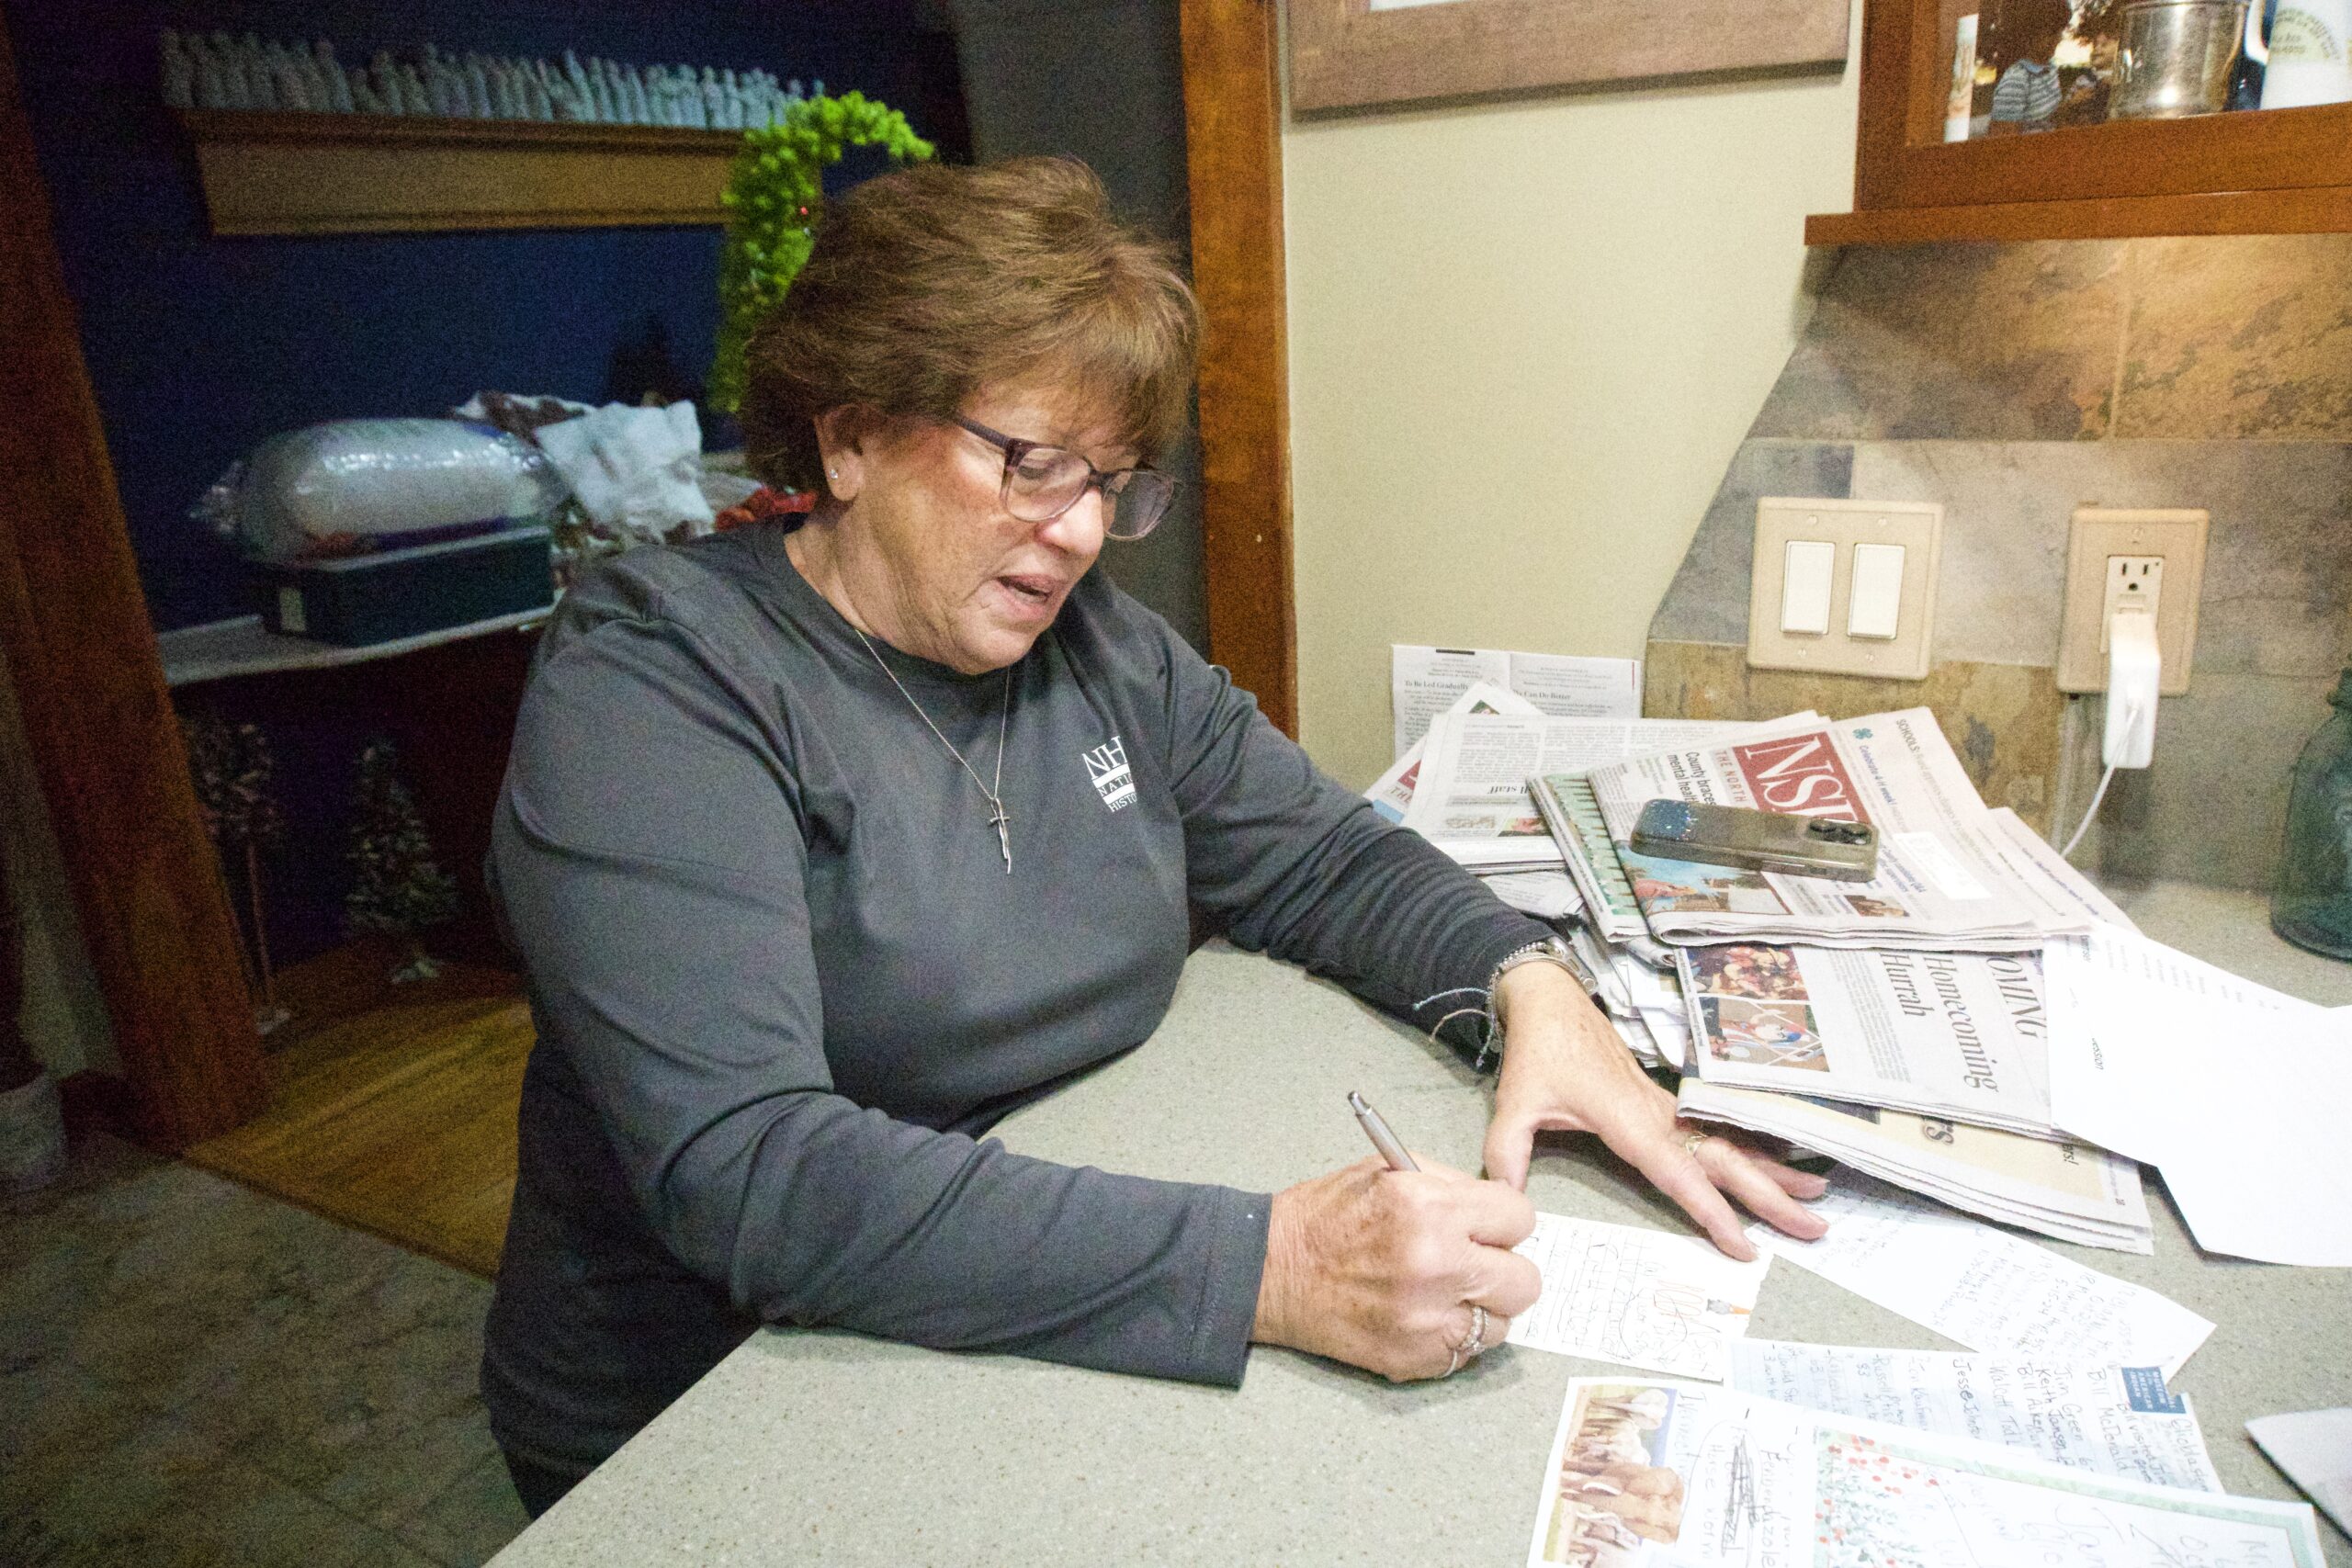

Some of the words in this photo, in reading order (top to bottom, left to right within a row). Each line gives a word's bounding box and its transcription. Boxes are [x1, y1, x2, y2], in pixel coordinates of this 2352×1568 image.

[1081, 735, 1128, 781] NH
[1668, 754, 1688, 781] mental
[1685, 751, 1705, 779] County
[1724, 770, 1746, 802] NORTH
[1880, 953, 1935, 1017] Hurrah
[1923, 956, 2000, 1093] Homecoming
[2016, 1361, 2036, 1390] Bill
[2029, 1398, 2045, 1437] Aiken
[2035, 1368, 2056, 1404] Keith
[2130, 1371, 2141, 1397] INDIAN
[2137, 1371, 2153, 1409] AMERICAN
[2061, 1404, 2084, 1442] Green
[2086, 1367, 2108, 1394] Bill
[2100, 1407, 2136, 1472] McDonald
